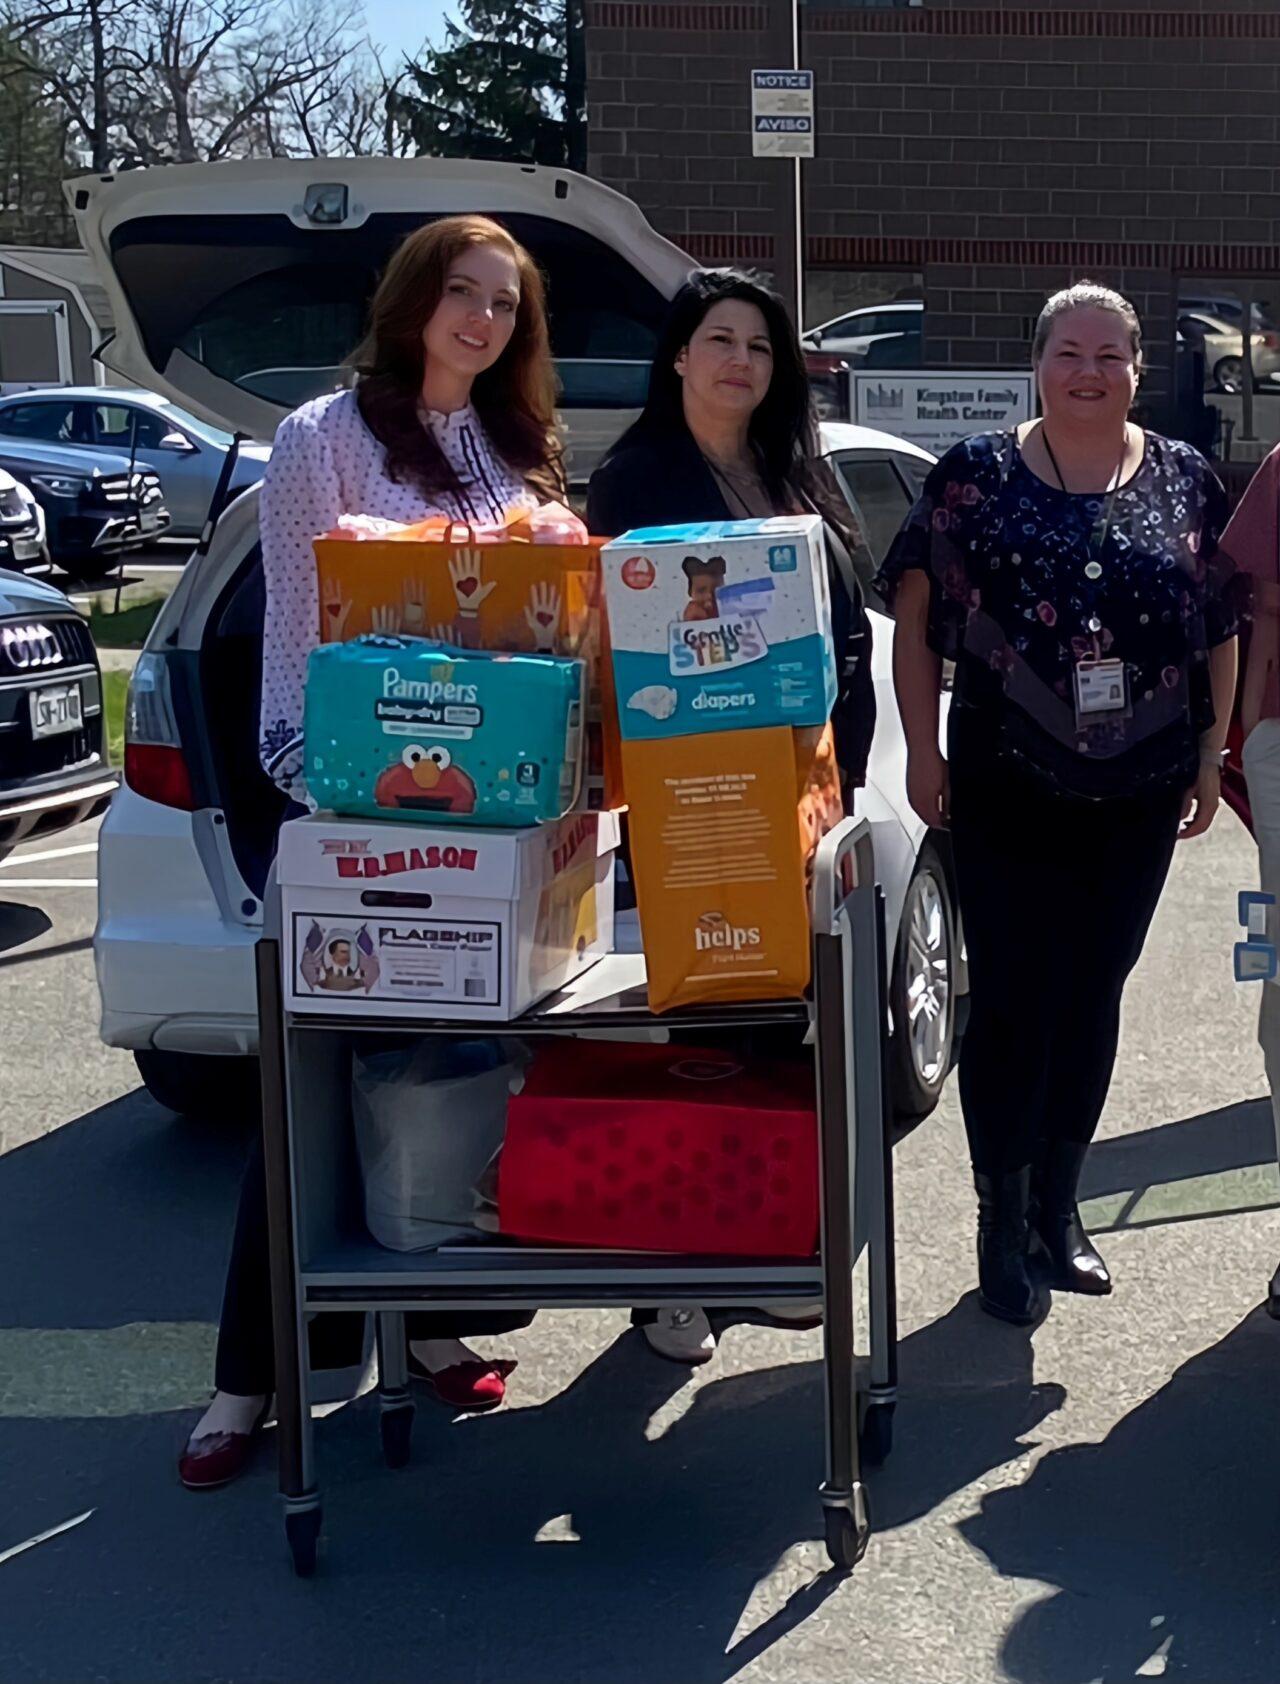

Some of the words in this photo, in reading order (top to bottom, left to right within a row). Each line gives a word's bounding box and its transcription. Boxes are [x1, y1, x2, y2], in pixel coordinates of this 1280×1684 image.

[756, 76, 807, 87] NOTICE
[757, 118, 809, 131] AVISO
[916, 388, 974, 406] Kingston
[977, 389, 1019, 406] Family
[916, 406, 959, 420] Health
[962, 406, 1008, 420] Center
[383, 667, 478, 705] Pampers
[691, 688, 755, 710] diapers
[695, 922, 761, 950] helps
